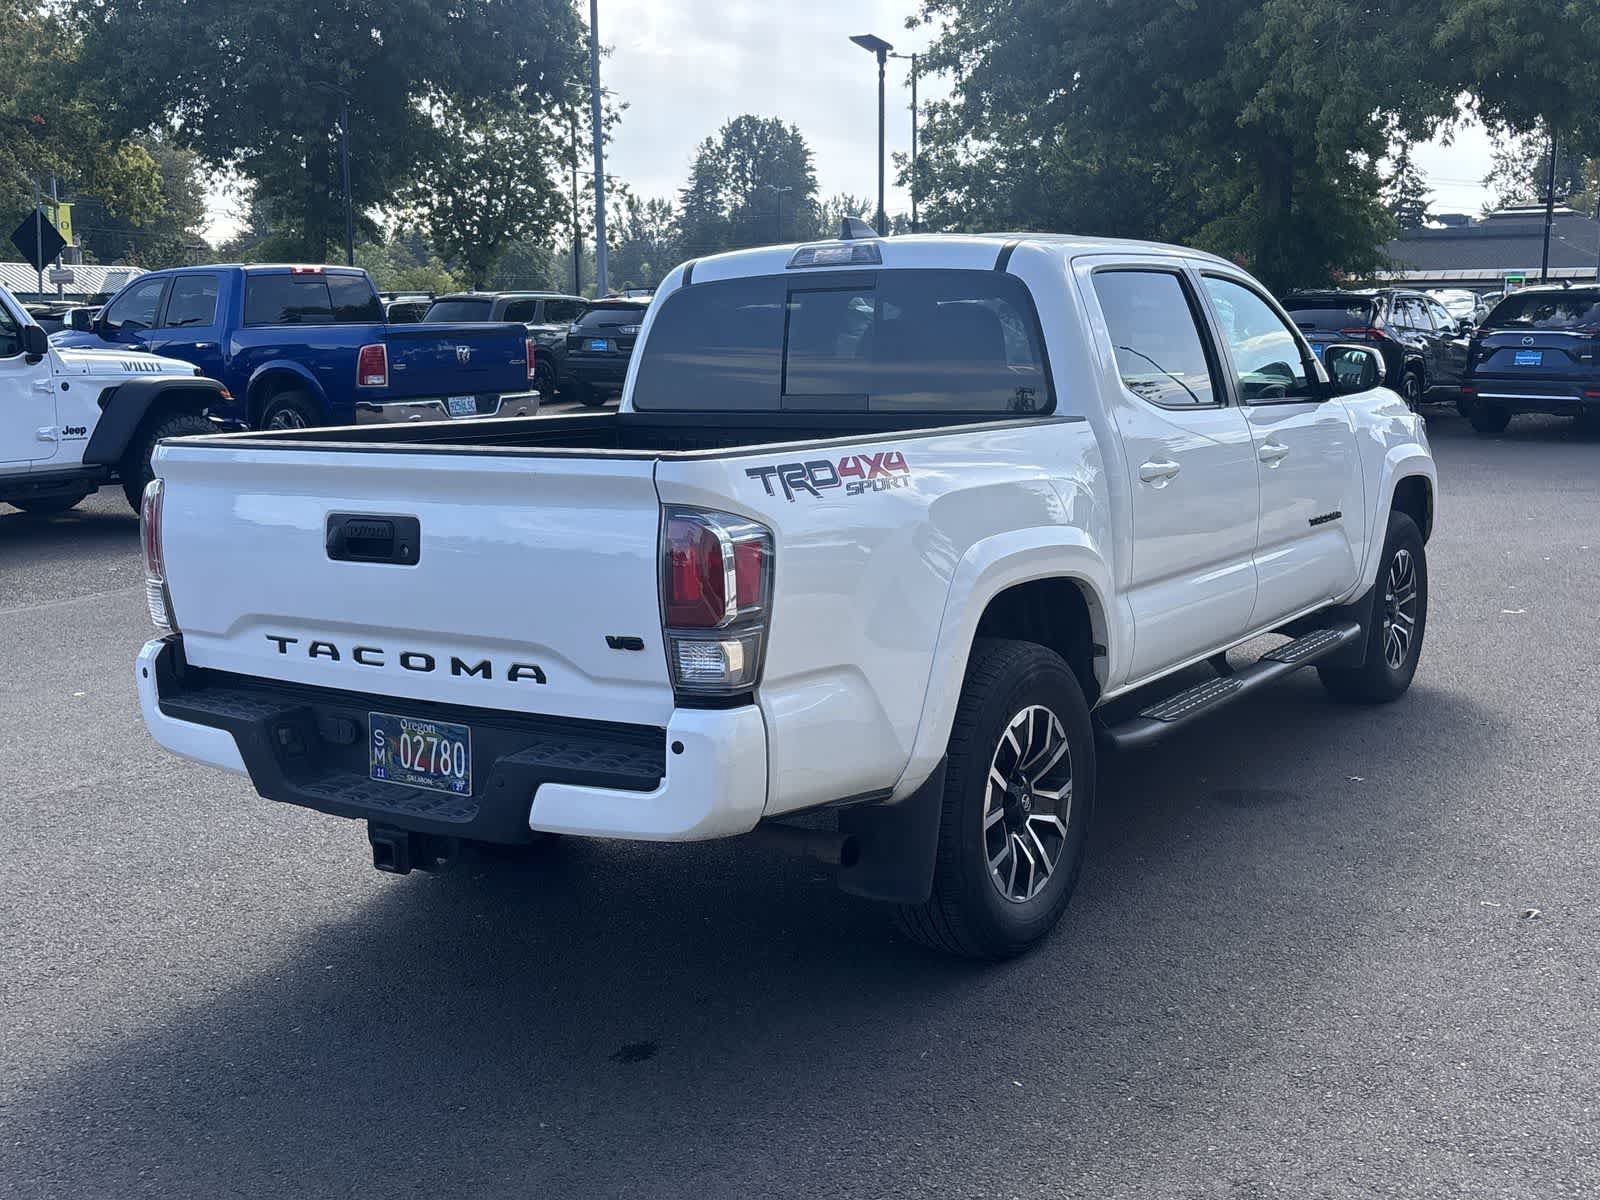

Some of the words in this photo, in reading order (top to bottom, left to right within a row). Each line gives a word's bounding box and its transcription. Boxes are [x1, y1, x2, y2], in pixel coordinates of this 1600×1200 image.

[120, 361, 162, 372] WILLYS
[62, 425, 87, 436] Jeep
[745, 459, 842, 503] TRD
[846, 475, 912, 497] SPORT
[605, 635, 644, 651] V6
[265, 634, 547, 685] TACOMA
[400, 719, 436, 735] Oregon
[400, 733, 465, 778] 02780
